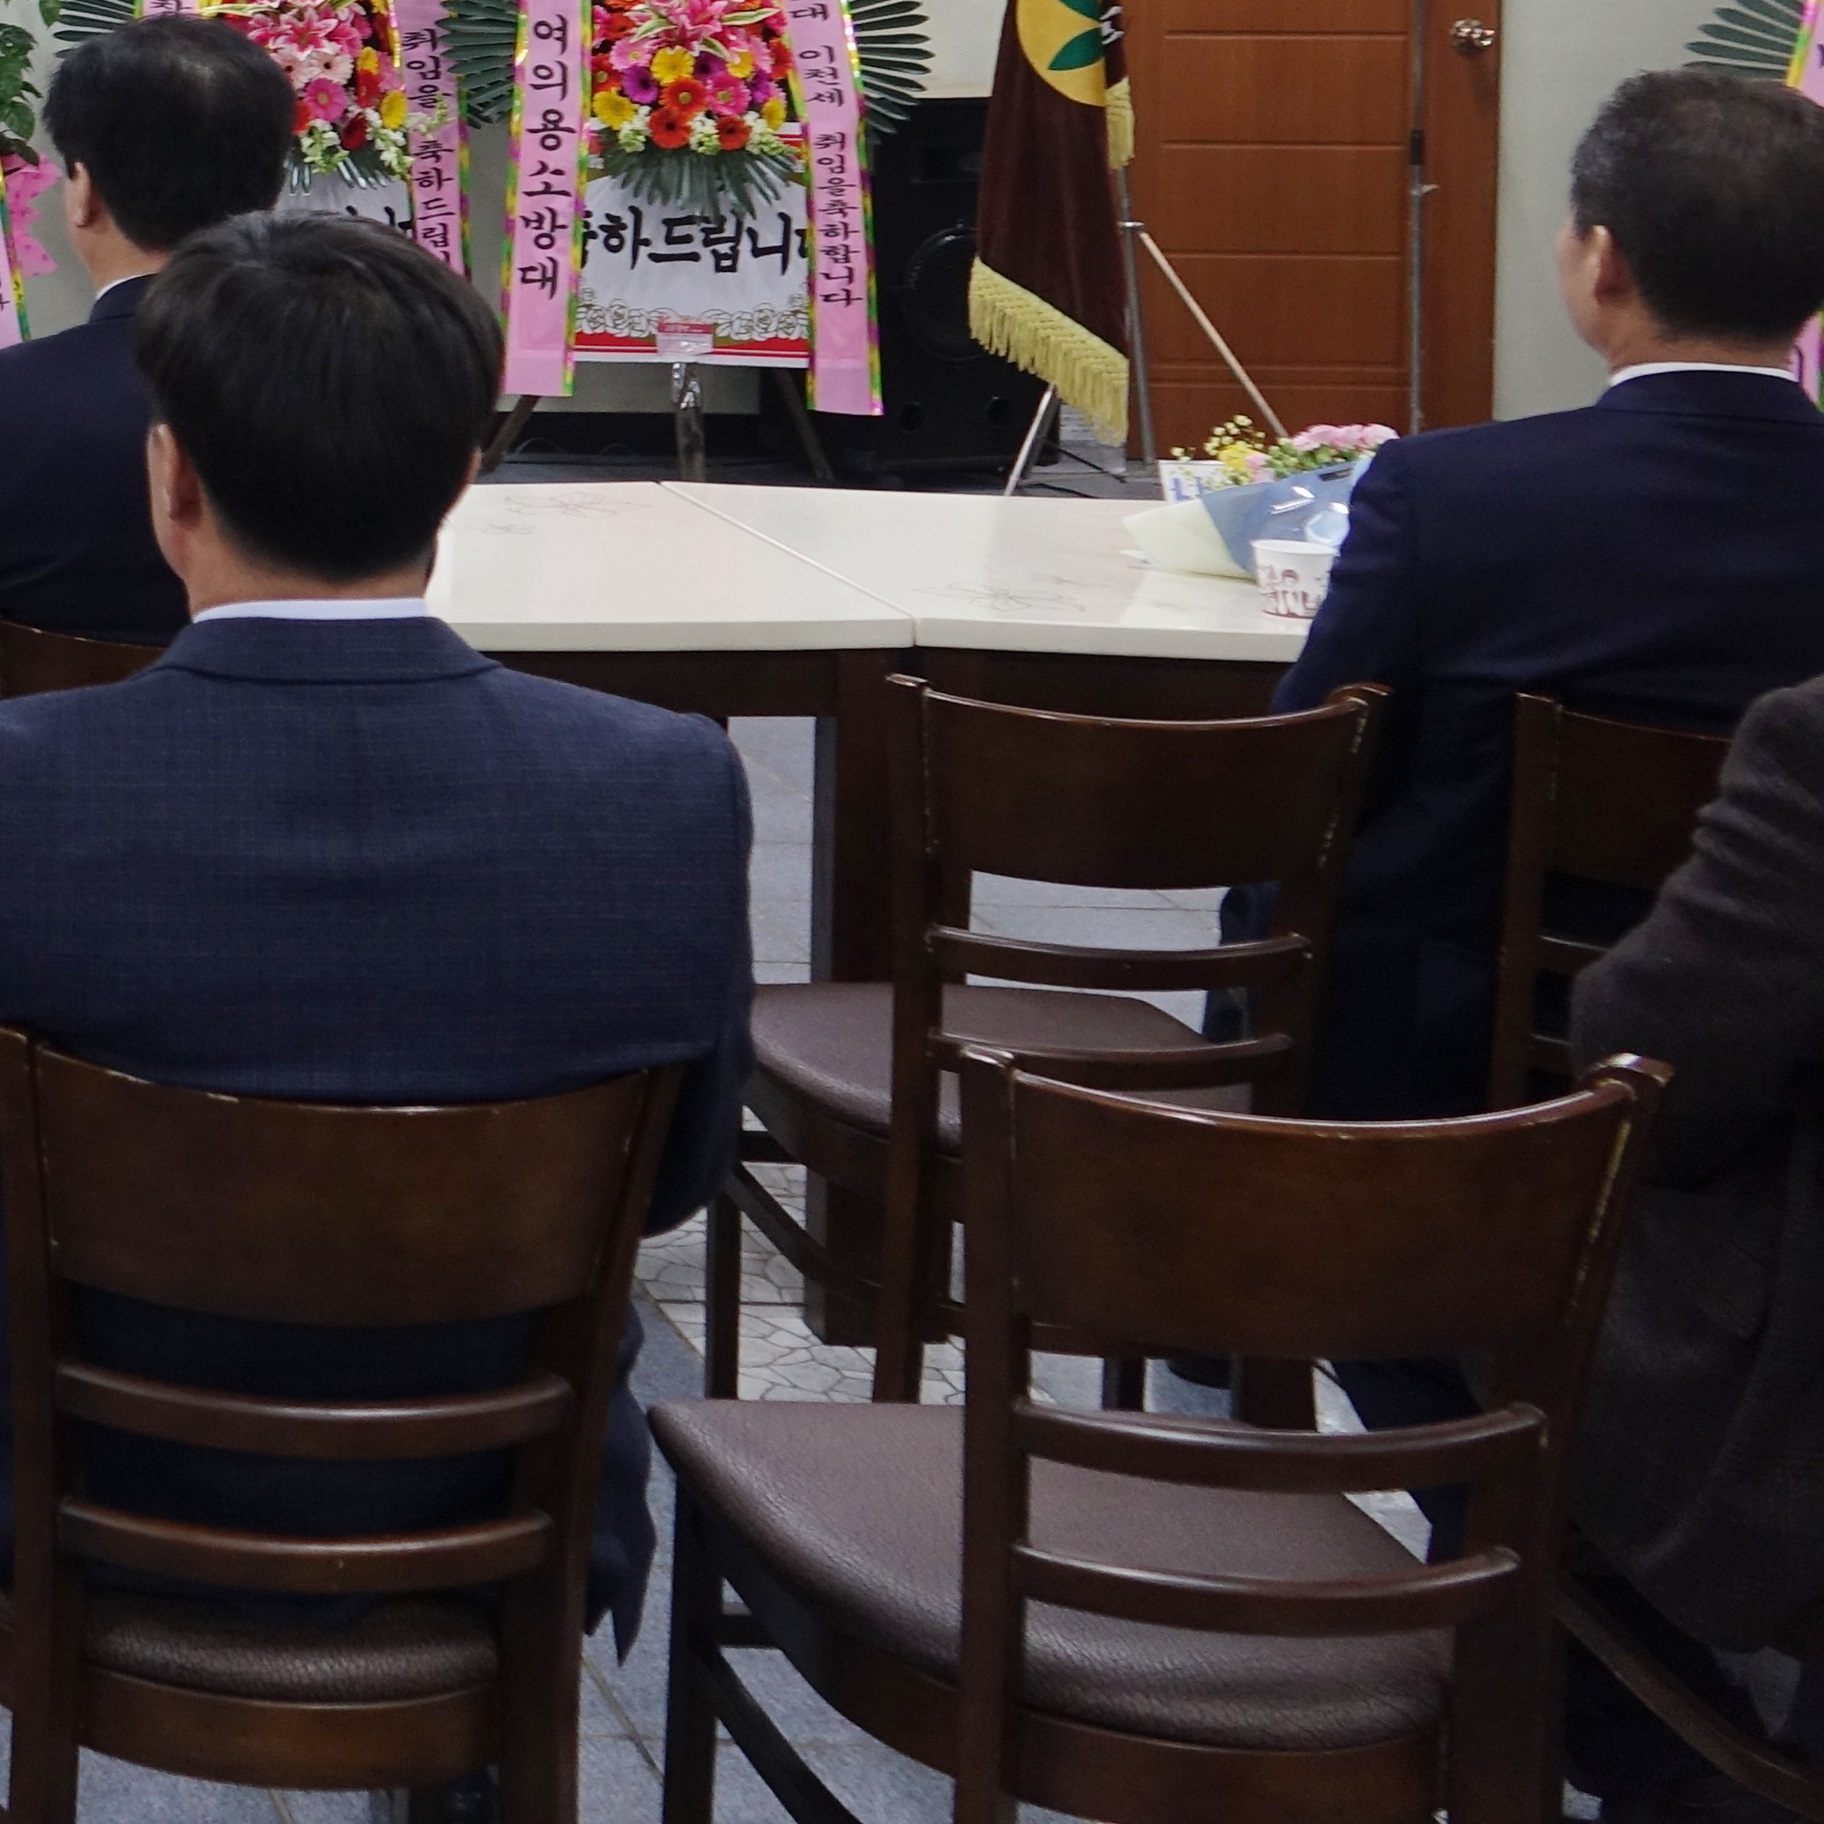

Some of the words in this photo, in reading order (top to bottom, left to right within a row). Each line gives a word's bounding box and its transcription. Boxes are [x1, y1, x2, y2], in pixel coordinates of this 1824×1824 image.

[401, 28, 452, 109] 취임을
[797, 44, 845, 108] 이천세
[412, 139, 456, 267] 축하드립
